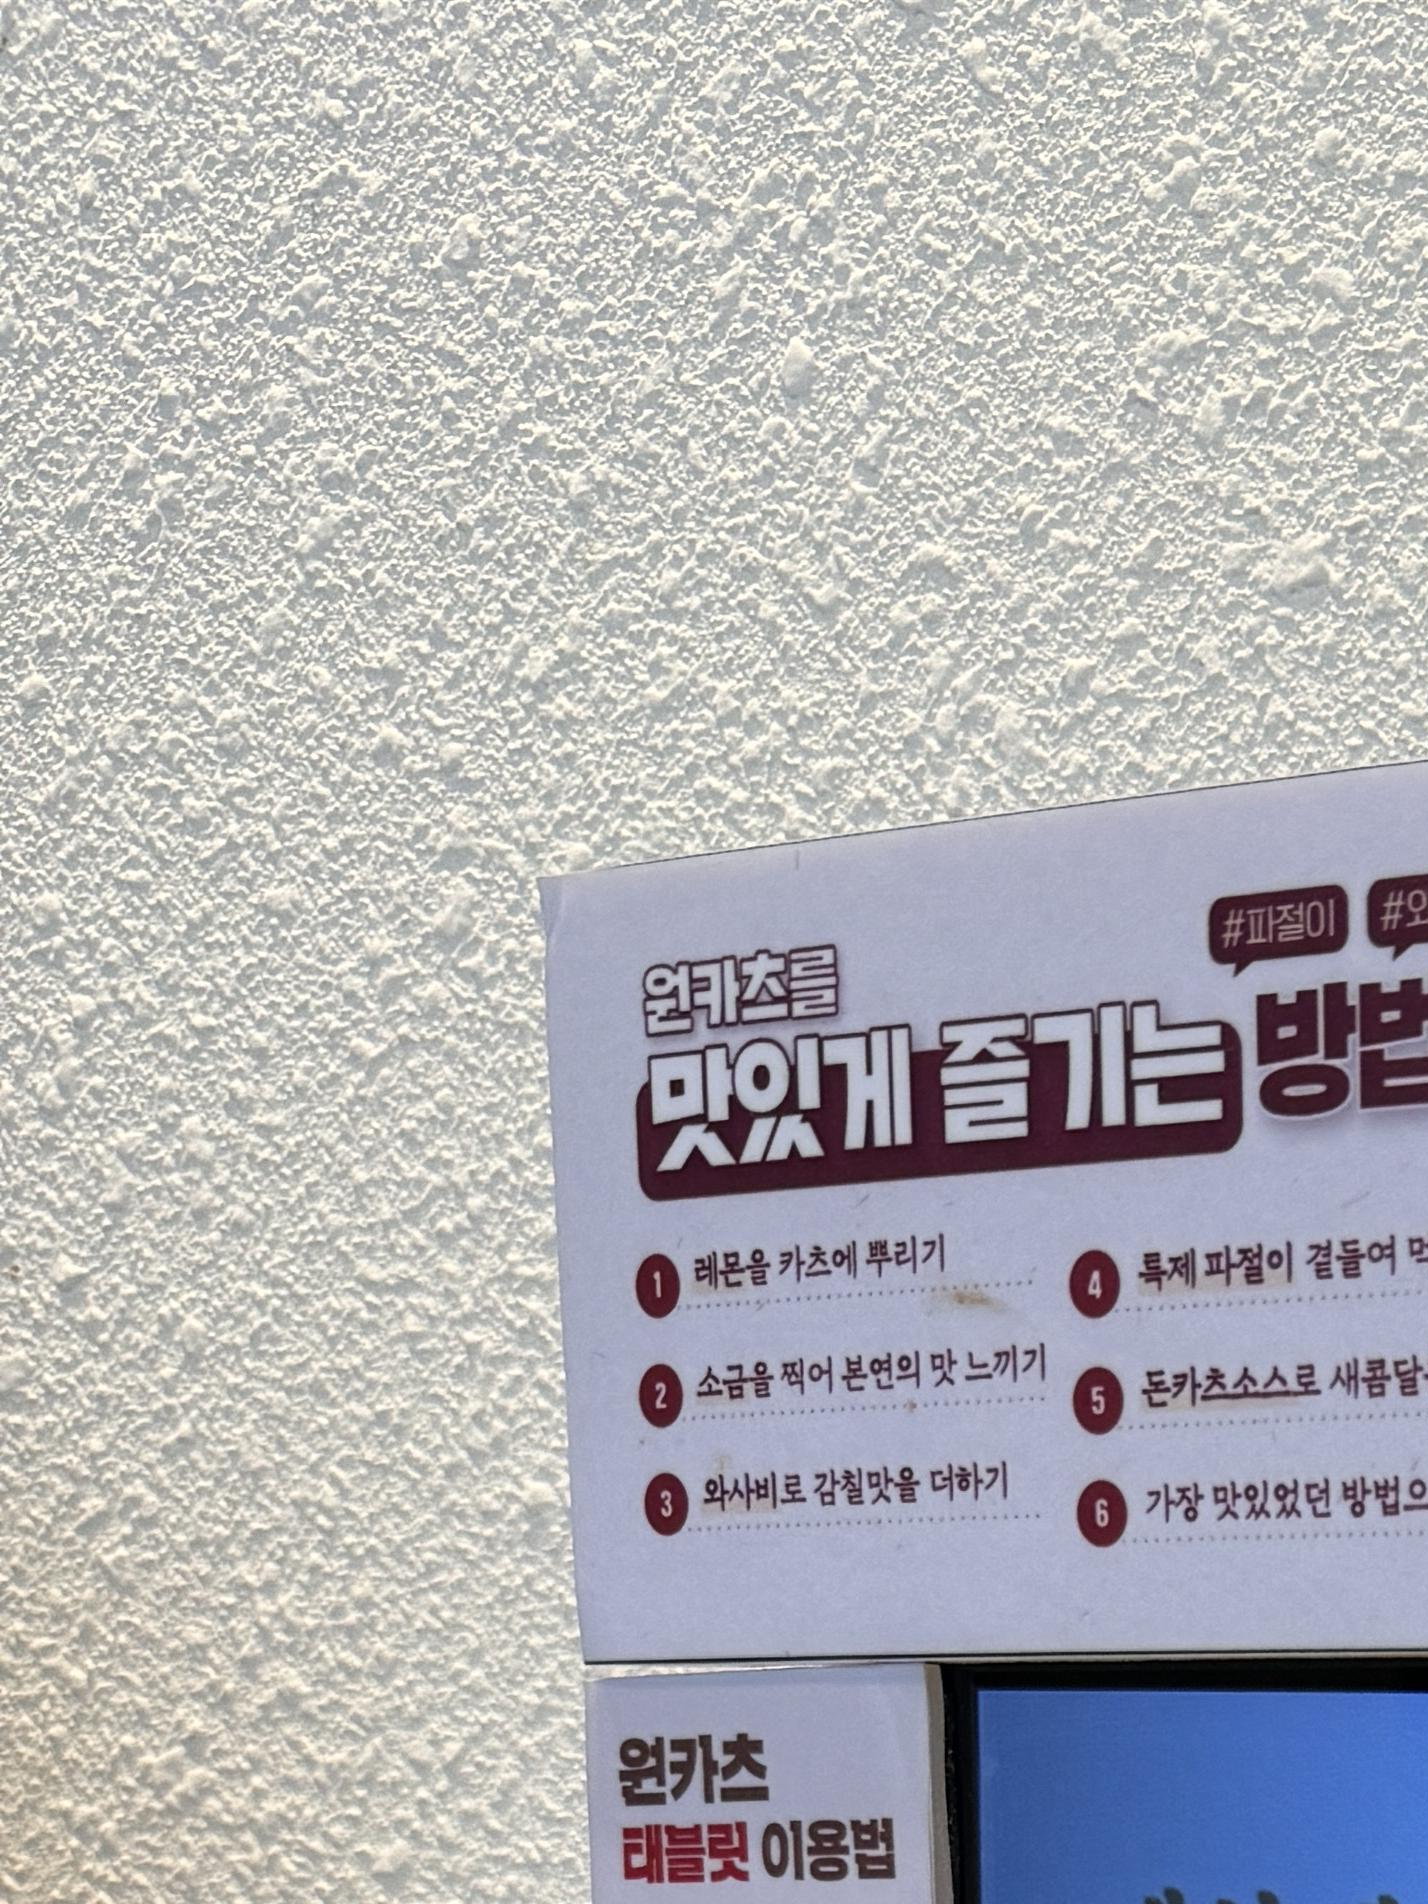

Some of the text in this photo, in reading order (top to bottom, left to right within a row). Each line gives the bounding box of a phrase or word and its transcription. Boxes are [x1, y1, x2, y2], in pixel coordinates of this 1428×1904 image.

[1221, 899, 1336, 949] #파절이
[642, 944, 839, 1037] 원카츠를
[648, 1024, 913, 1173] 맛있게
[940, 999, 1226, 1145] 즐기는
[694, 1233, 945, 1290] 레몬을 카츠에 뿌리기
[1138, 1248, 1197, 1291] 특제
[1204, 1241, 1293, 1287] 파절이
[1306, 1234, 1396, 1280] 곁들여
[696, 1343, 1046, 1400] 소금을 찍어 본연의 맛 느끼기
[1141, 1363, 1322, 1408] 돈카츠소스로
[703, 1461, 1009, 1511] 와사비로 감칠맛을 더하기
[1145, 1484, 1204, 1523] 가장
[1212, 1478, 1331, 1521] 맛있었던
[618, 1733, 769, 1806] 원카츠
[622, 1817, 896, 1884] 태블릿 이용법
